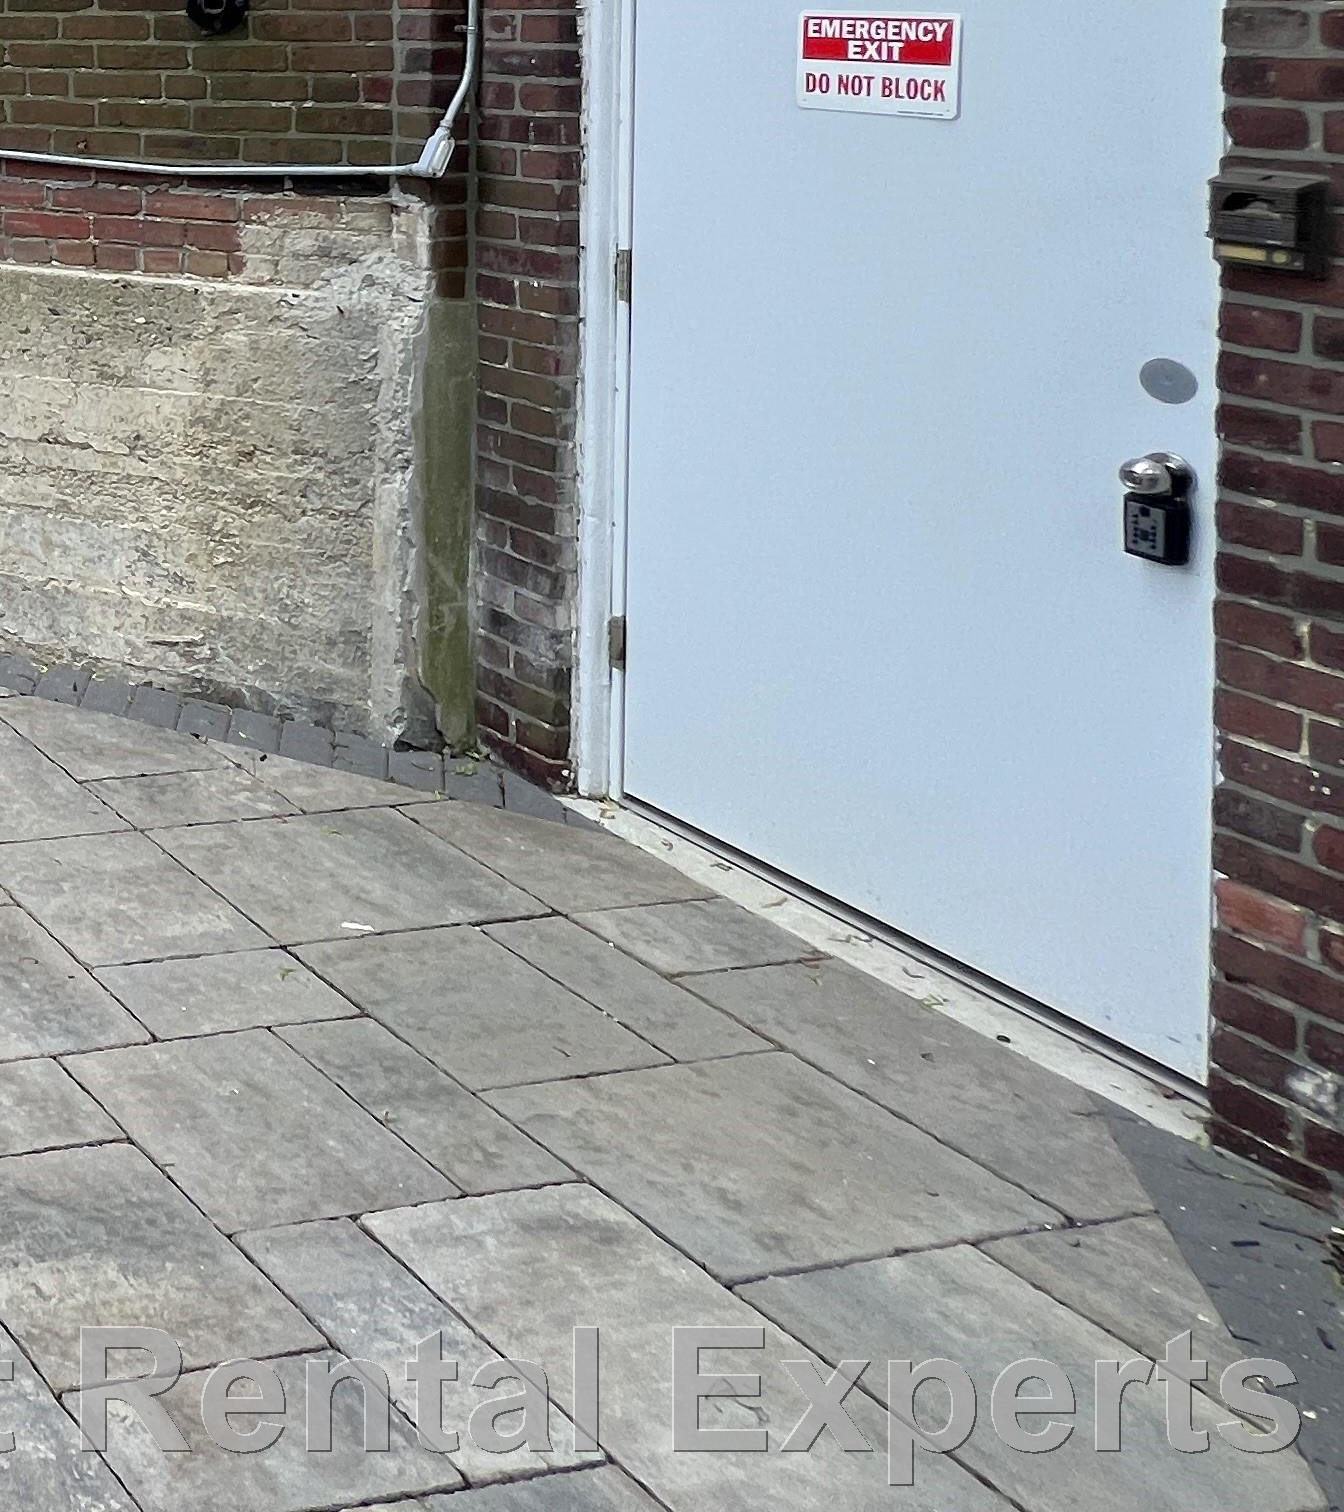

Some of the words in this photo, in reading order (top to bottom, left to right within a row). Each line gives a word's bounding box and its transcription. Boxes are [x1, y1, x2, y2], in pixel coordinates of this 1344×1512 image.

[807, 18, 949, 43] EMERGENCY
[847, 40, 905, 61] EXIT
[805, 72, 830, 94] DO
[837, 74, 875, 97] NOT
[881, 76, 946, 102] BLOCK
